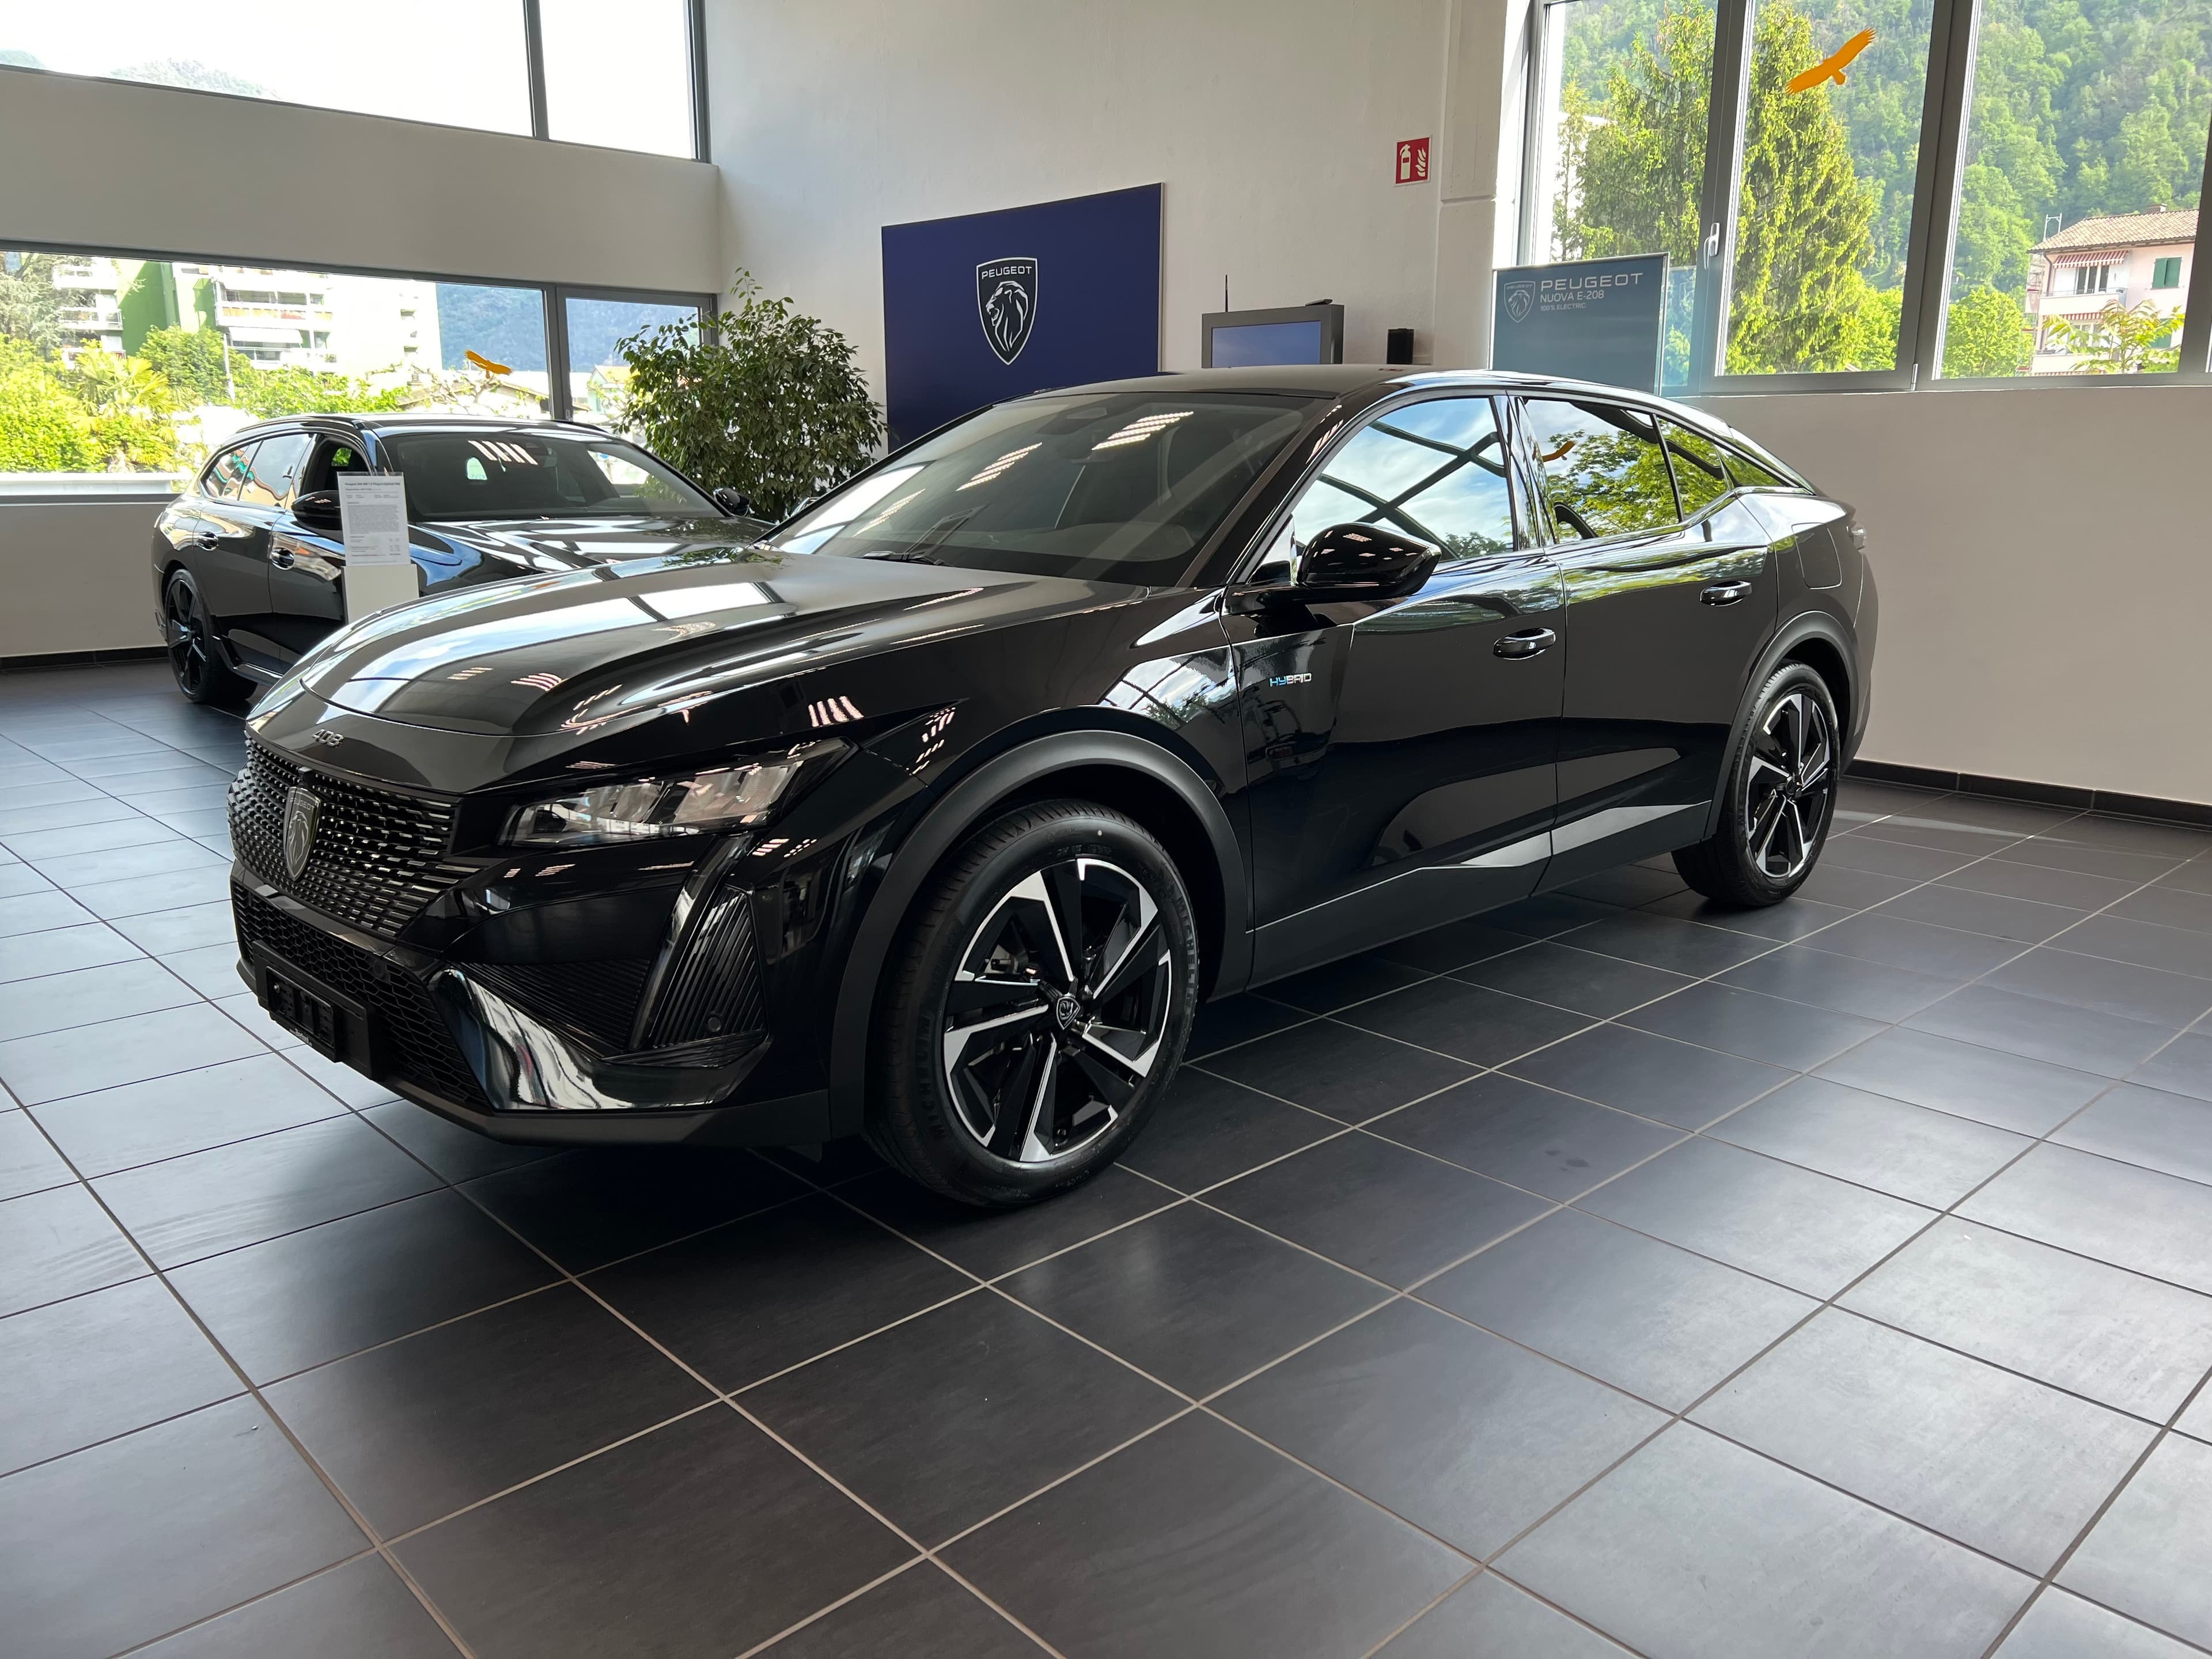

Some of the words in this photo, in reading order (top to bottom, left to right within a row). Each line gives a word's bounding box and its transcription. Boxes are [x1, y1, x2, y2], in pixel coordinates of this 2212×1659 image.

[981, 266, 1032, 280] PEUGEOT
[1541, 272, 1643, 291] PEUGEOT
[1540, 292, 1574, 304] NUOVA
[1577, 290, 1605, 300] E-208
[1270, 673, 1312, 687] HYBRID
[312, 729, 344, 747] 408
[290, 797, 315, 812] PEUGEOT
